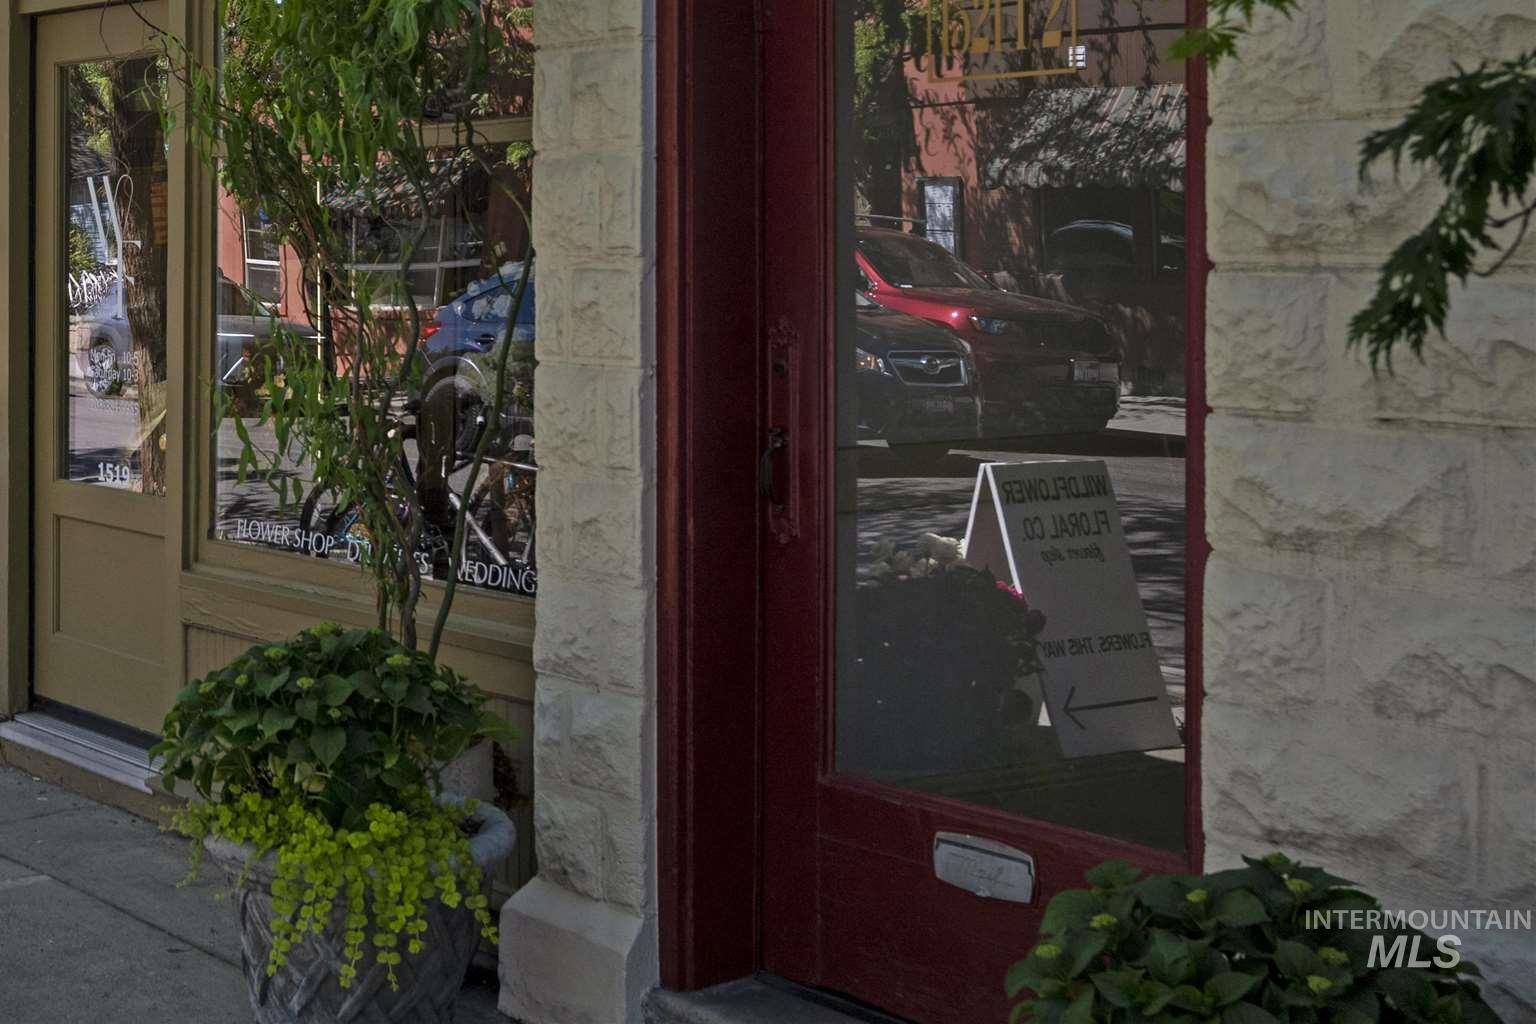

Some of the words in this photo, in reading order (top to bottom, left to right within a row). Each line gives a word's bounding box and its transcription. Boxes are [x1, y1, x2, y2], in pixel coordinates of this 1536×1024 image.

[123, 368, 139, 384] 10-3
[98, 461, 130, 483] 1519
[237, 519, 290, 546] FLOWER
[292, 528, 335, 554] SHOP
[448, 556, 537, 593] WEDDING
